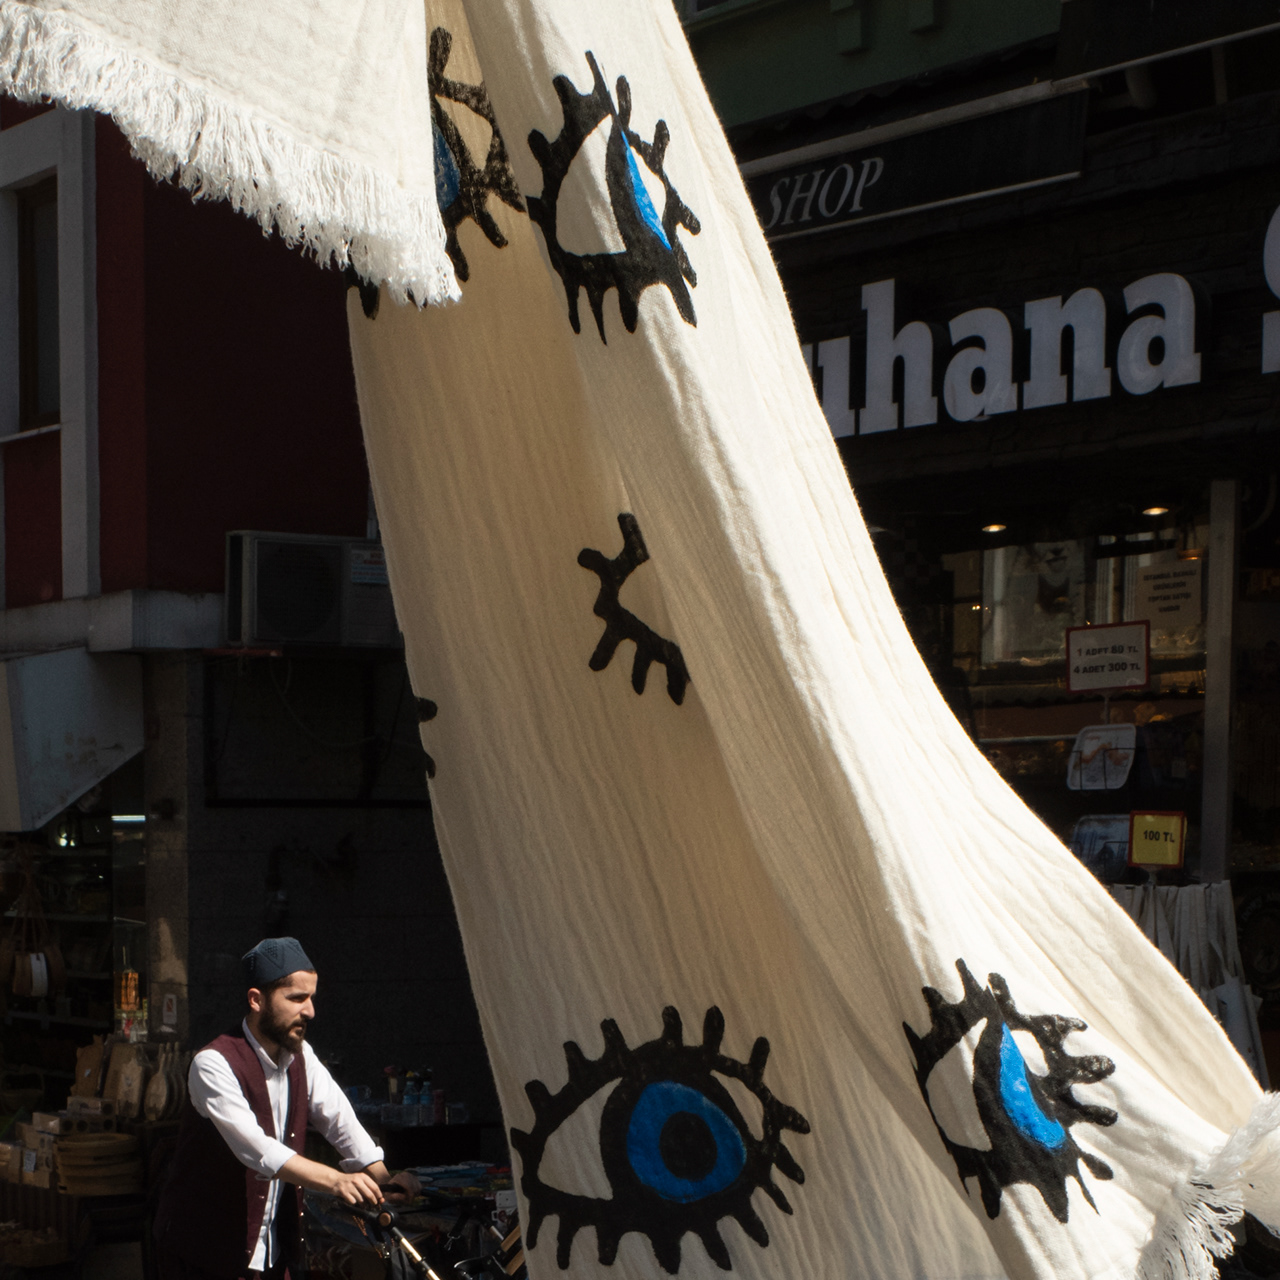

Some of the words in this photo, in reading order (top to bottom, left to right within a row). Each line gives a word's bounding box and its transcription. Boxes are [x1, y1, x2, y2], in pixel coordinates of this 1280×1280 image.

[766, 157, 884, 229] SHOP
[1127, 645, 1139, 653] TL
[1082, 665, 1106, 674] ADET
[1108, 662, 1128, 672] 300
[1130, 663, 1141, 671] TL
[1143, 830, 1160, 841] 100
[1163, 831, 1175, 843] TL
